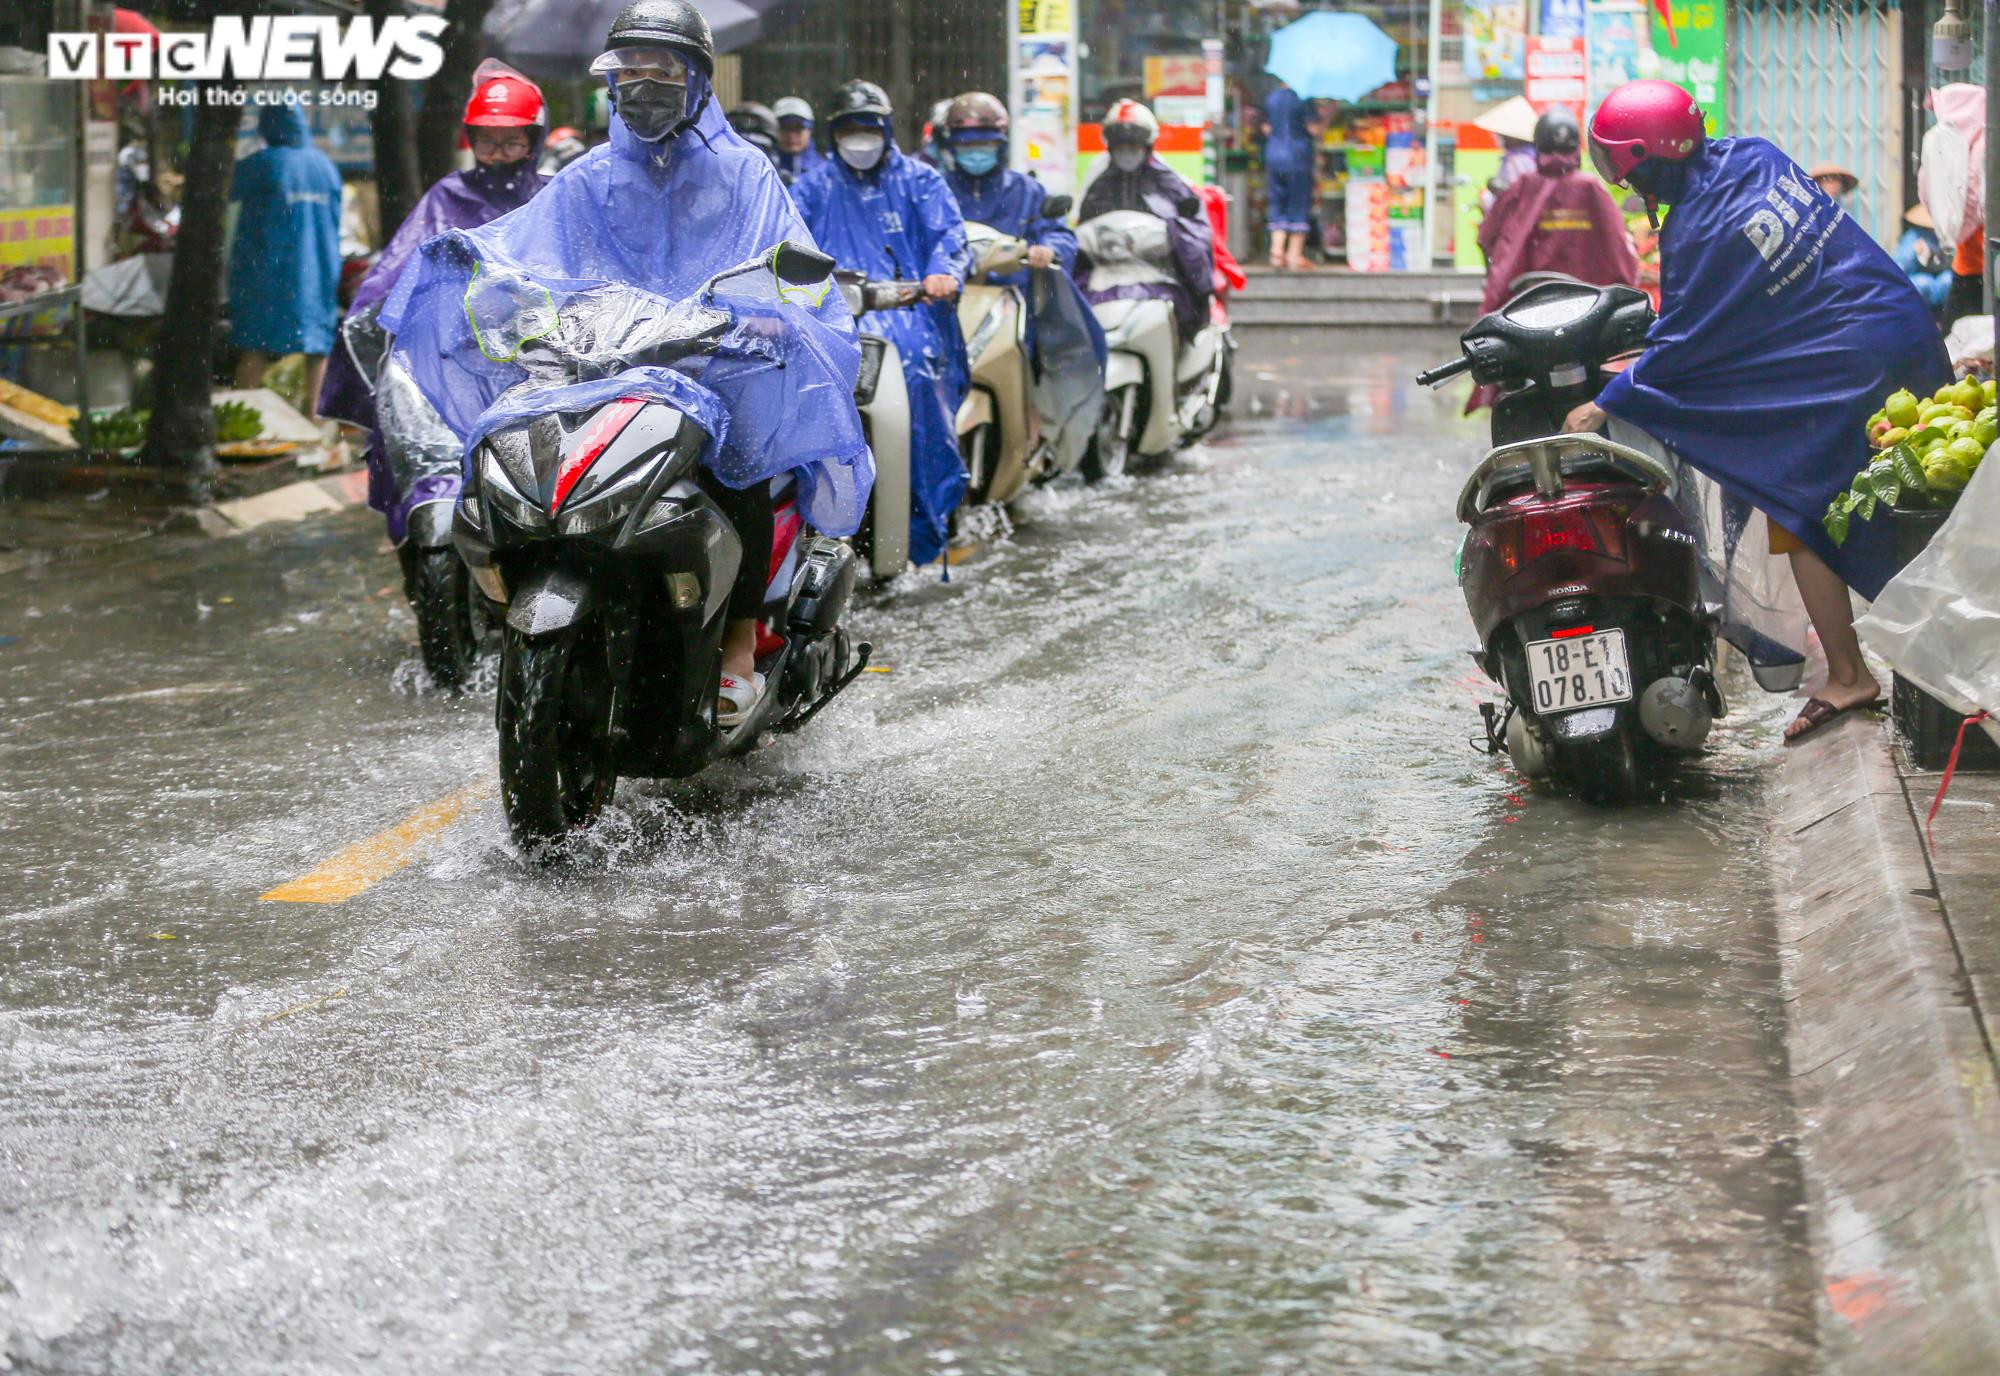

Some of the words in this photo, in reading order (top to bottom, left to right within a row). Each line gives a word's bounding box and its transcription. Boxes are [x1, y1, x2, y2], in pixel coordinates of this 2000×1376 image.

[1547, 584, 1589, 597] HONDA
[1543, 636, 1611, 675] 18-E1
[1537, 667, 1625, 708] 078.10
